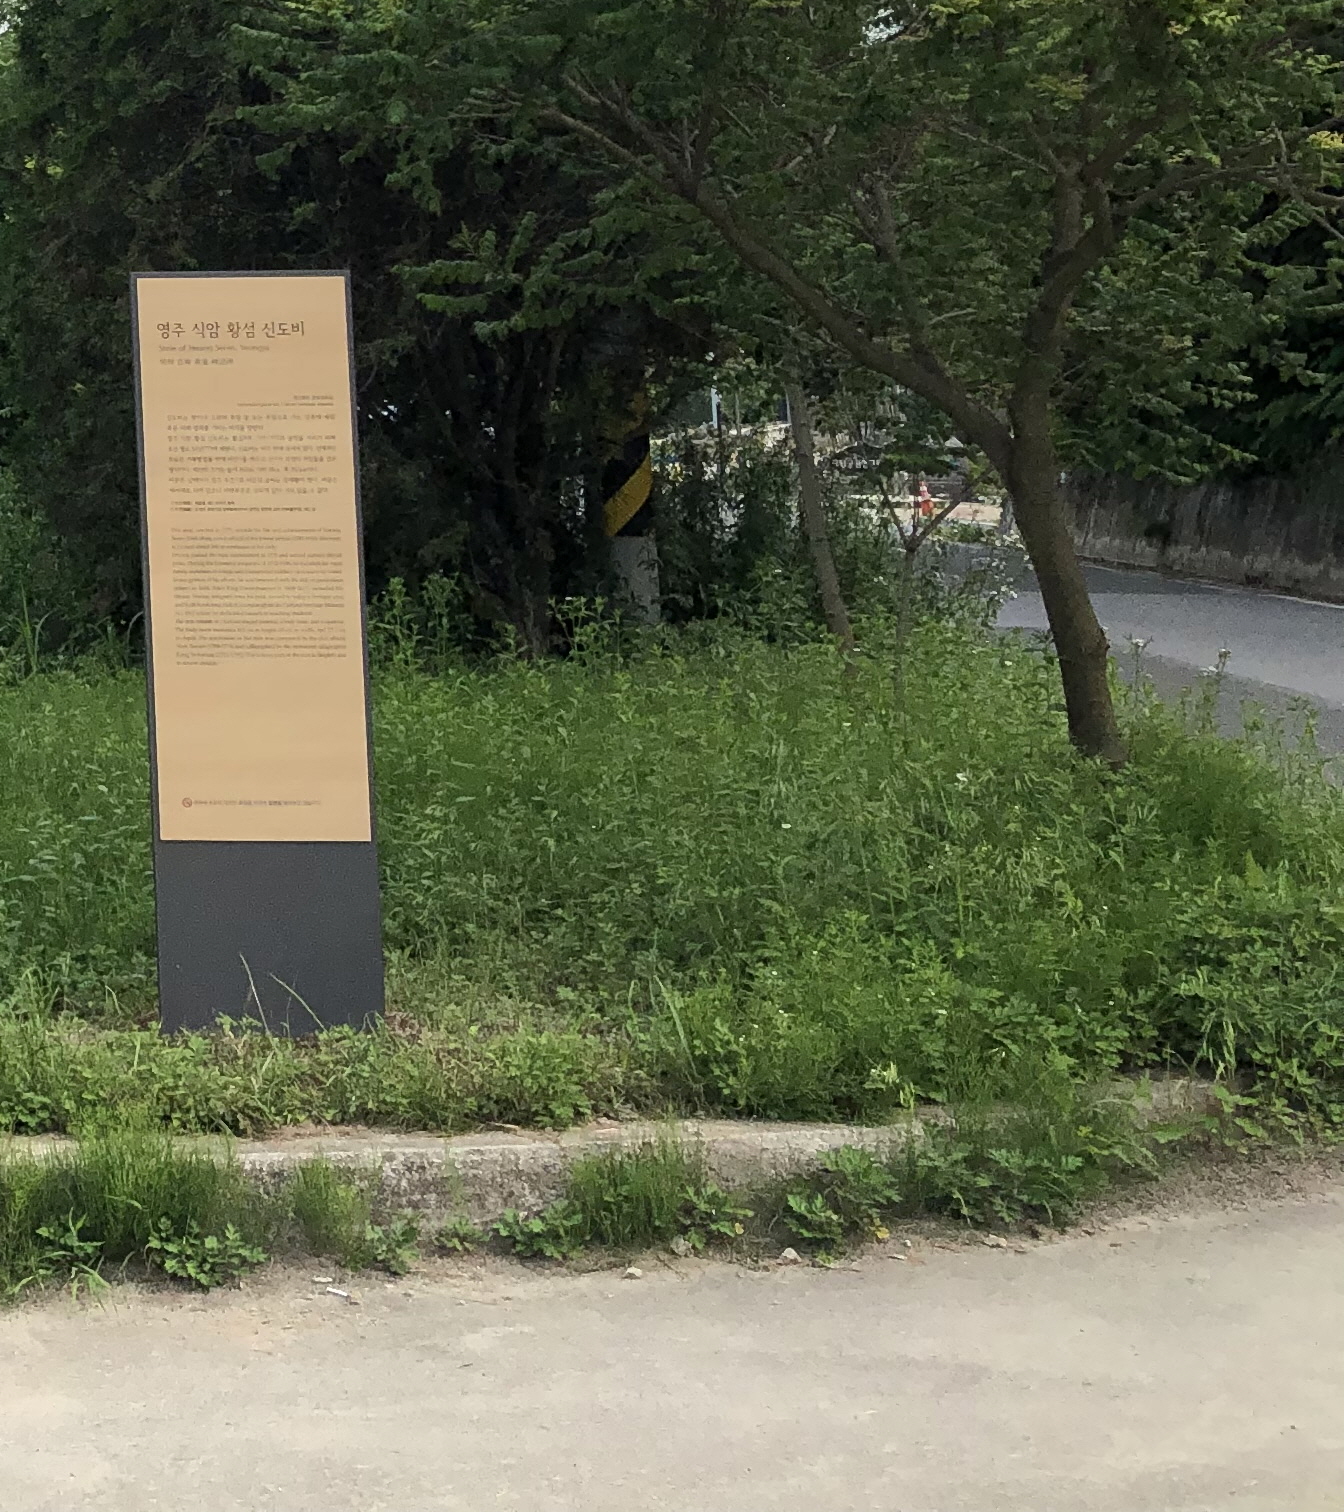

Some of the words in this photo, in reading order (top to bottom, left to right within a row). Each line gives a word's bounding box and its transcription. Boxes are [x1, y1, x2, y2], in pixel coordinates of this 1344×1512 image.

[156, 321, 186, 340] 영주
[191, 321, 221, 339] 식암
[226, 321, 256, 339] 황섬
[261, 320, 305, 338] 신도비
